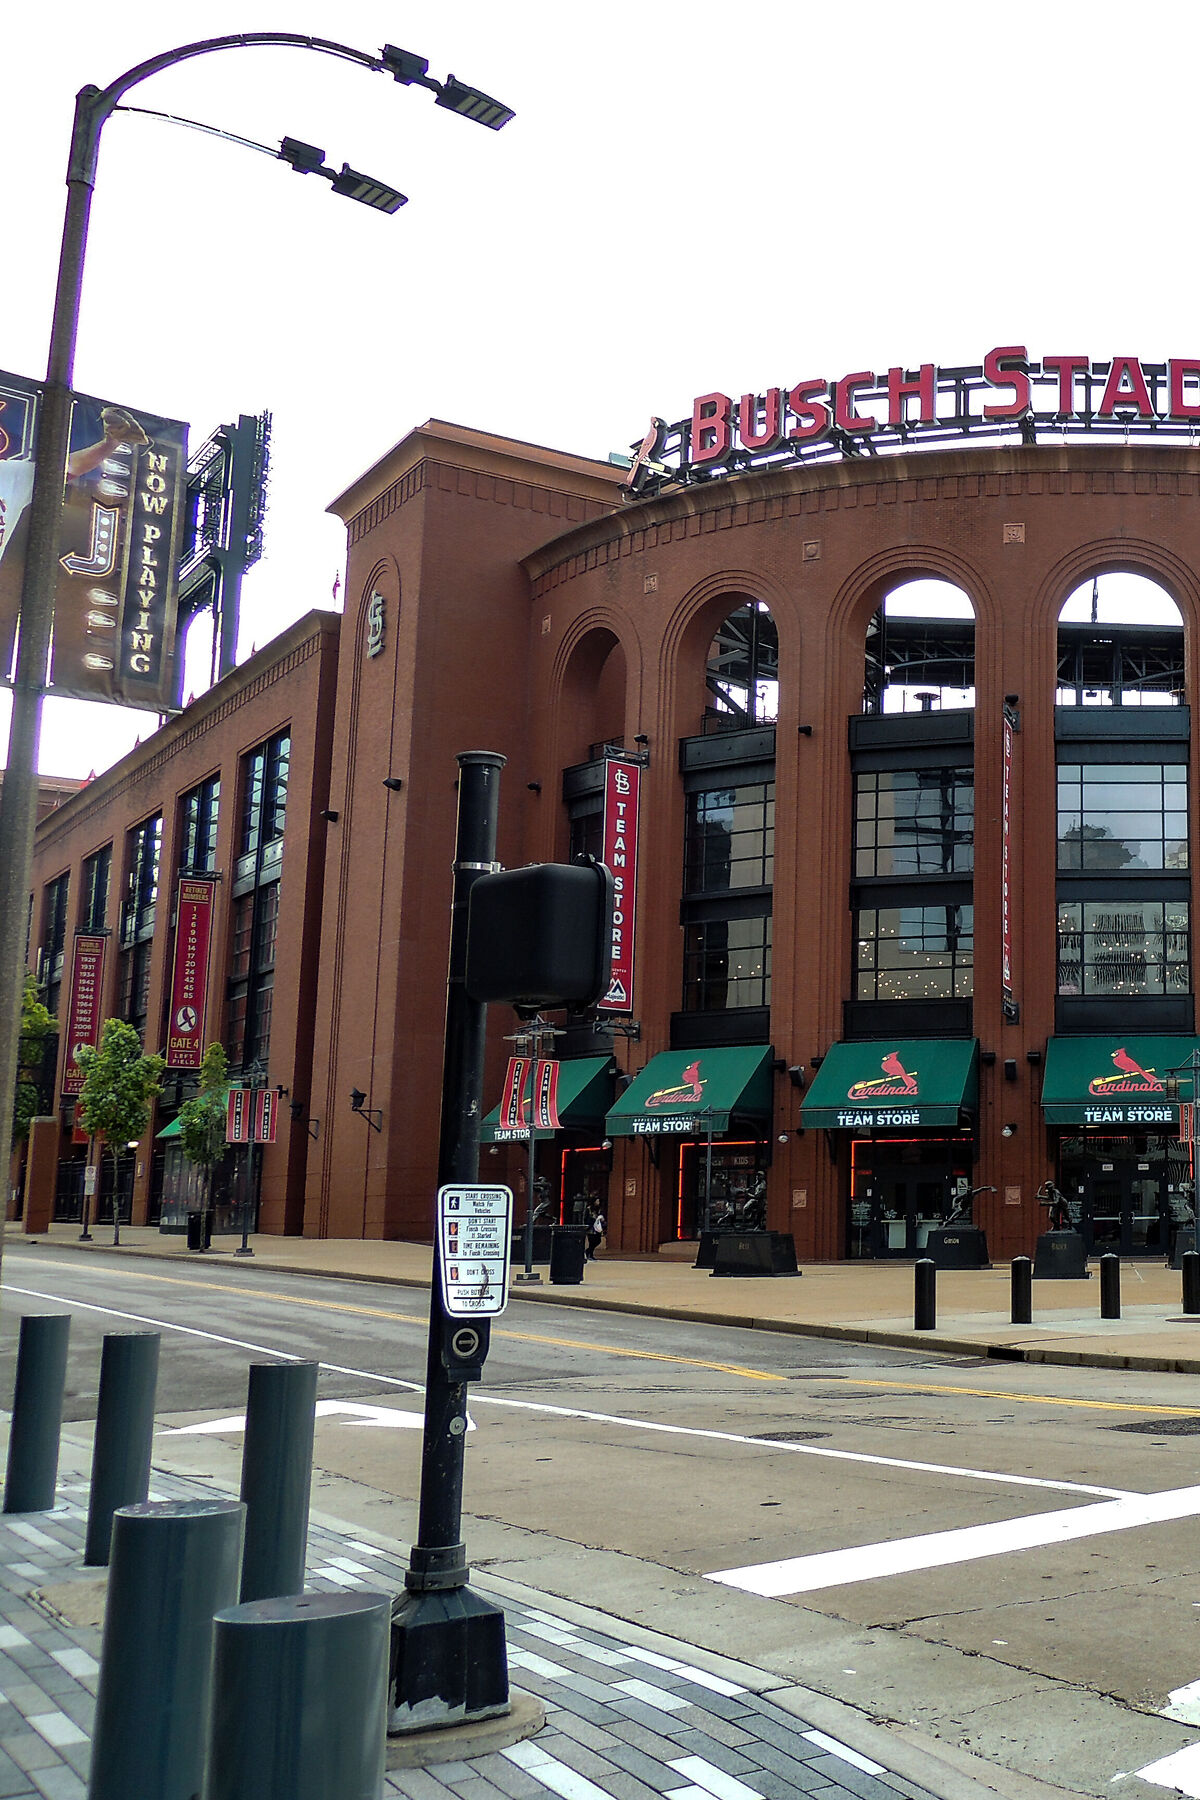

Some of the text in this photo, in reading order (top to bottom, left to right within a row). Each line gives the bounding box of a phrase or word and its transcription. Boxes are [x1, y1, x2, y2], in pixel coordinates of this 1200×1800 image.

[691, 362, 938, 464] BUSCH
[129, 450, 168, 674] NOW PLAYING
[613, 802, 627, 868] TEAM
[611, 876, 624, 960] STORE
[188, 936, 196, 944] 10
[171, 1037, 199, 1049] GATE 4
[542, 1066, 550, 1091] TEAM
[1088, 1077, 1164, 1096] Cardinals
[645, 1090, 703, 1108] Cardinals
[847, 1081, 919, 1100] Cardinals
[837, 1113, 920, 1126] TEAM STORE
[1084, 1110, 1173, 1122] TEAM STORE
[494, 1128, 531, 1140] TEAM STOR
[633, 1122, 660, 1133] TEAM
[734, 1157, 749, 1165] KIDS
